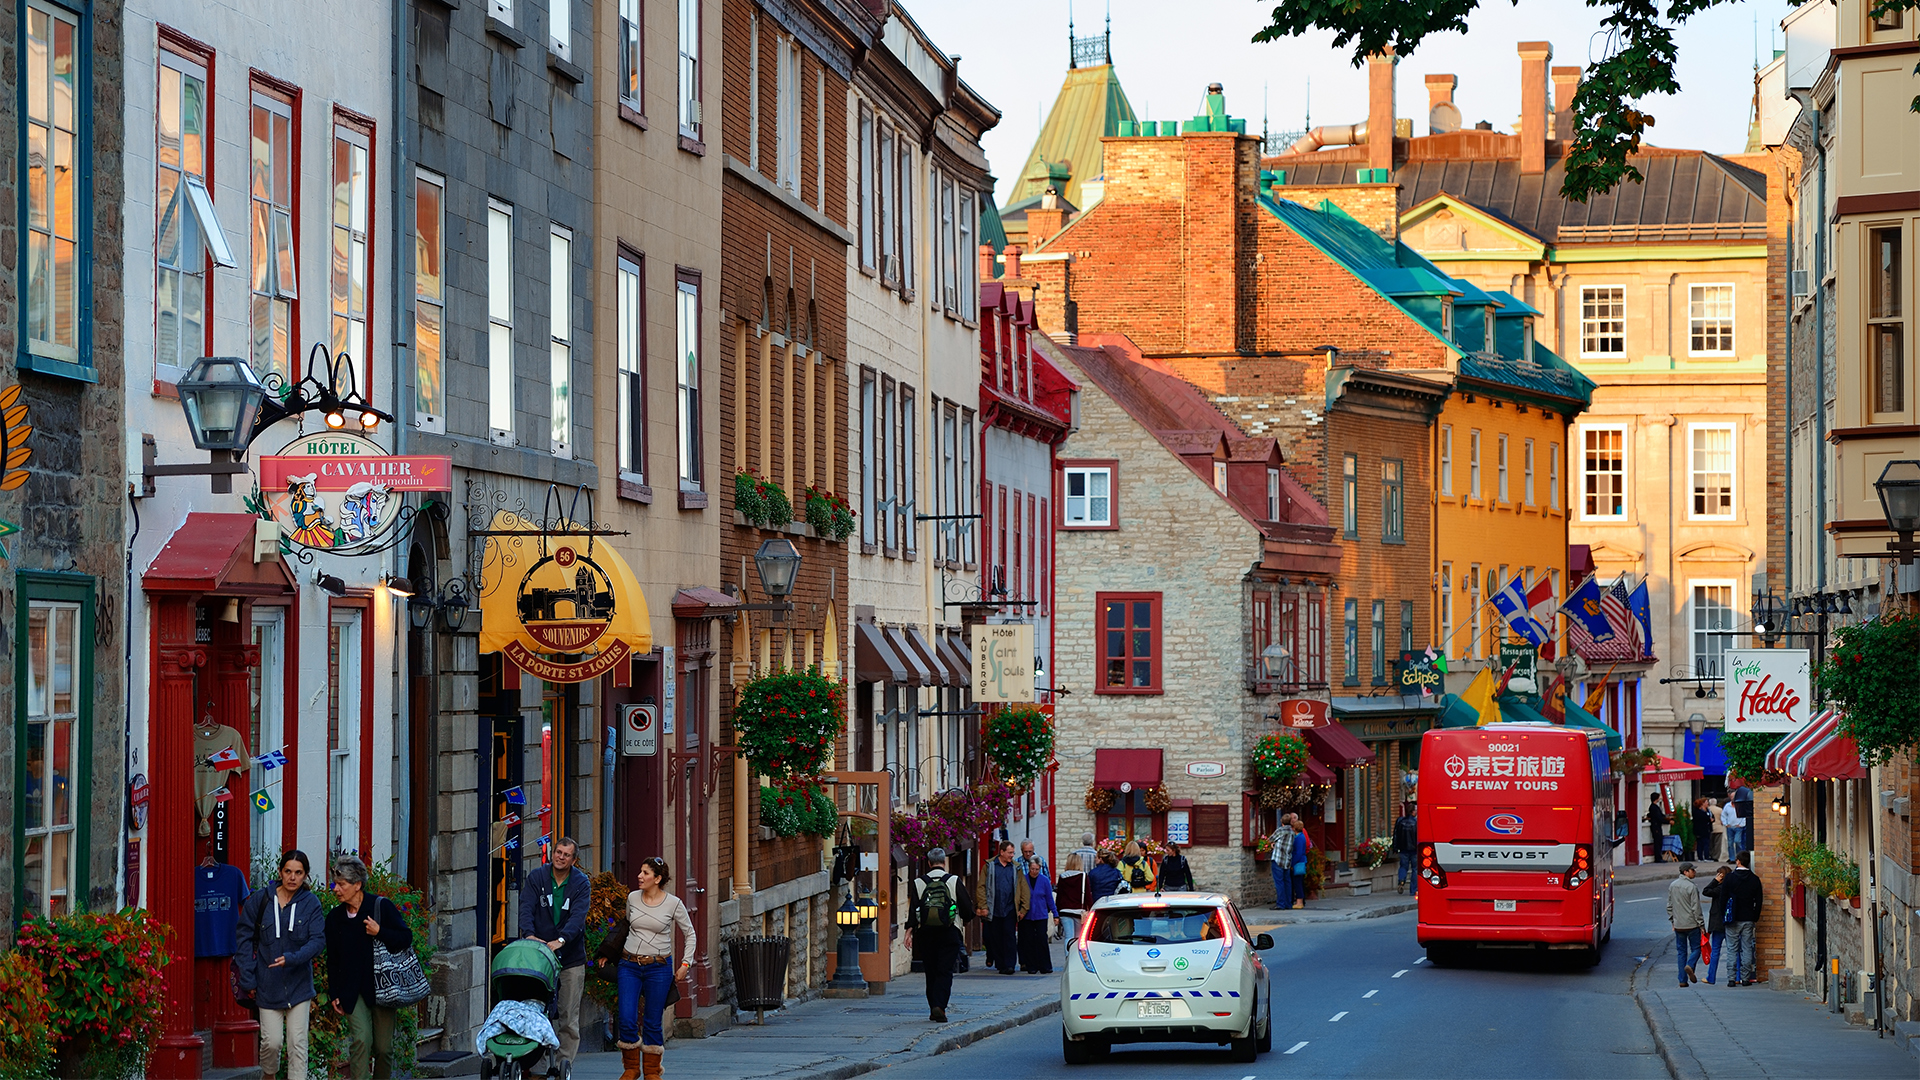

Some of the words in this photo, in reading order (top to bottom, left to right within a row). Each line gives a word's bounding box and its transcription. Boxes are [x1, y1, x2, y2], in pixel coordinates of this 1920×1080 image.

[307, 440, 360, 455] HÔTEL
[321, 462, 411, 476] CAVALIER
[370, 475, 384, 486] du
[388, 475, 423, 486] moulin
[559, 551, 570, 562] 56
[542, 627, 591, 646] SOUVENIRS
[992, 628, 1016, 637] Hôtel
[510, 645, 526, 663] LA
[525, 659, 566, 679] PORTE
[989, 640, 1017, 682] Saint
[998, 660, 1025, 698] Louis
[1734, 660, 1761, 684] petite
[1736, 674, 1801, 723] Italie
[626, 739, 633, 747] DE
[634, 739, 641, 747] CE
[1488, 743, 1520, 752] 90021
[1467, 755, 1566, 778] 泰安旅遊
[1451, 780, 1509, 790] SAFEWAY
[1515, 780, 1558, 791] TOURS
[1461, 851, 1549, 859] PREVOST
